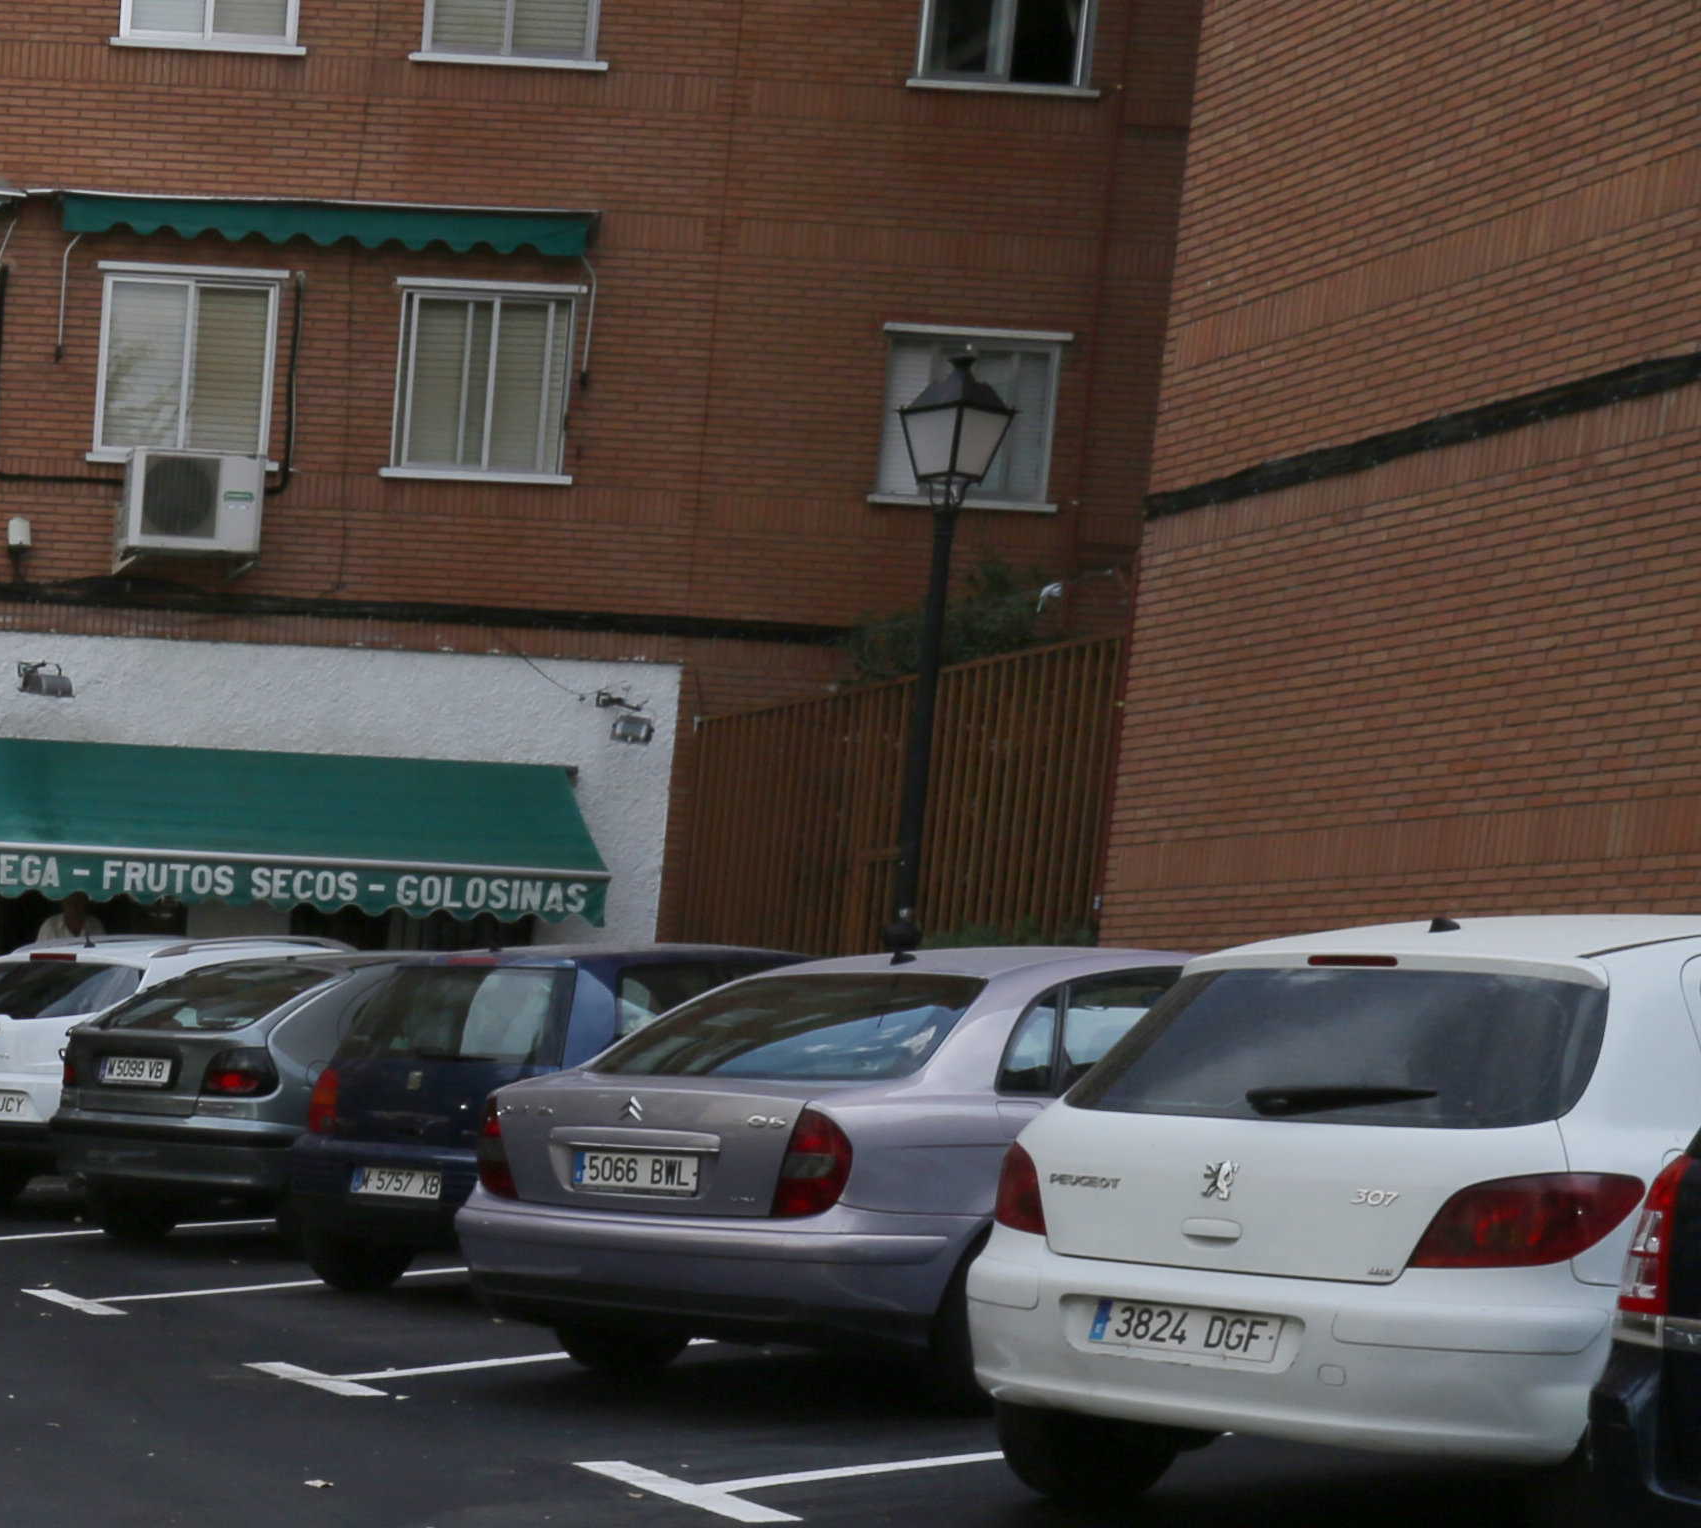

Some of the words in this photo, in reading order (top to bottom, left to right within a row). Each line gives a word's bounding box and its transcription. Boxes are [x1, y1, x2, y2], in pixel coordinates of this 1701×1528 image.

[102, 860, 234, 896] FRUTOS
[250, 867, 358, 901] SECOS
[397, 875, 587, 913] GOLOSINAS
[148, 1062, 164, 1079] VB
[747, 1115, 787, 1129] C5
[588, 1156, 638, 1183] 5066
[650, 1158, 690, 1186] BWL
[1049, 1173, 1121, 1190] PEUGEOT
[375, 1170, 415, 1193] 5757
[419, 1172, 441, 1196] XB
[1351, 1188, 1400, 1207] 307
[1114, 1305, 1189, 1346] 3824
[1203, 1315, 1269, 1353] DGF
